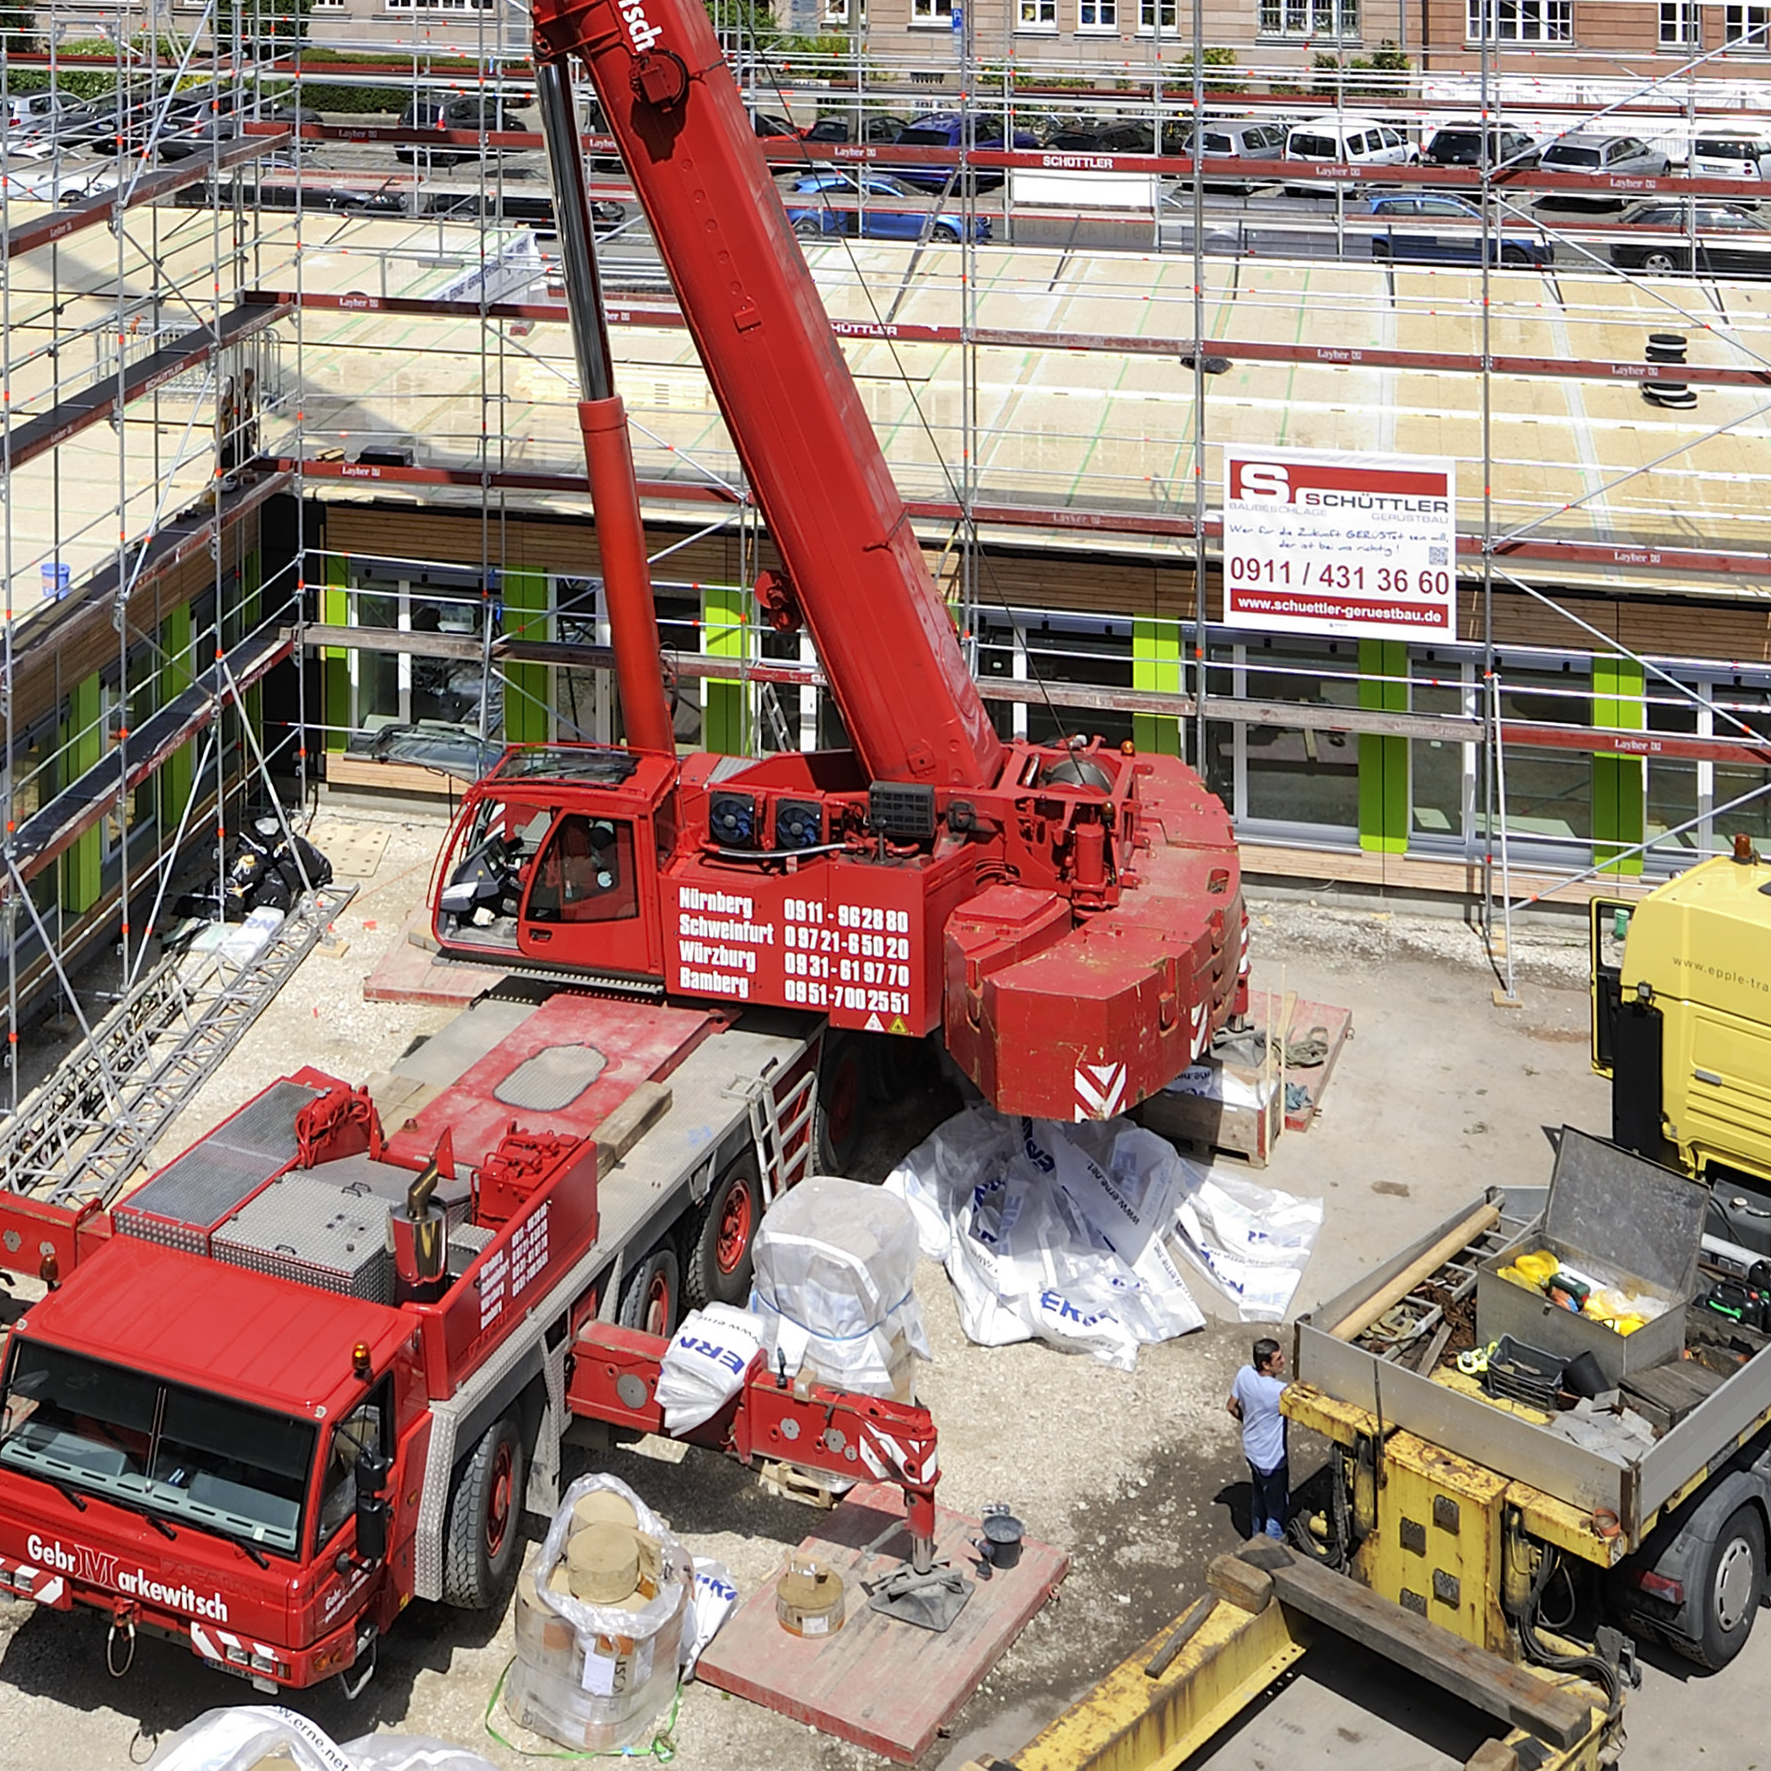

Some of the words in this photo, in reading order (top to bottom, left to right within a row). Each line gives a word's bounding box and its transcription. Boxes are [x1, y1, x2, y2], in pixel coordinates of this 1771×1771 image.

[590, 138, 617, 149] Layhe
[834, 145, 865, 157] Layher
[1315, 165, 1348, 177] Layher
[1610, 178, 1643, 189] Layher
[339, 299, 367, 309] Layher
[1317, 349, 1350, 360] Layher
[1611, 364, 1645, 376] Layher
[342, 466, 370, 477] Layher
[1240, 463, 1290, 504] S
[1305, 492, 1449, 513] SCHÜTTLER
[1614, 551, 1647, 563] Layher
[1230, 556, 1290, 584] 0911
[1302, 561, 1311, 586] /
[1319, 563, 1364, 590] 431
[1377, 567, 1408, 593] 36
[1418, 570, 1450, 596] 60
[1237, 596, 1442, 623] www.schuettler-geruestbau.de
[1614, 739, 1648, 751] Layher
[679, 886, 753, 919] Nürnberg
[784, 898, 824, 924] 0911
[679, 913, 774, 945] Schweinfurt
[679, 939, 757, 973] Würzburg
[679, 966, 749, 999] Bamberg
[680, 1336, 745, 1375] ERN
[27, 1534, 76, 1573] Gebr
[74, 1543, 228, 1622] Markewitsch
[278, 1705, 349, 1771] w.erne.ne
